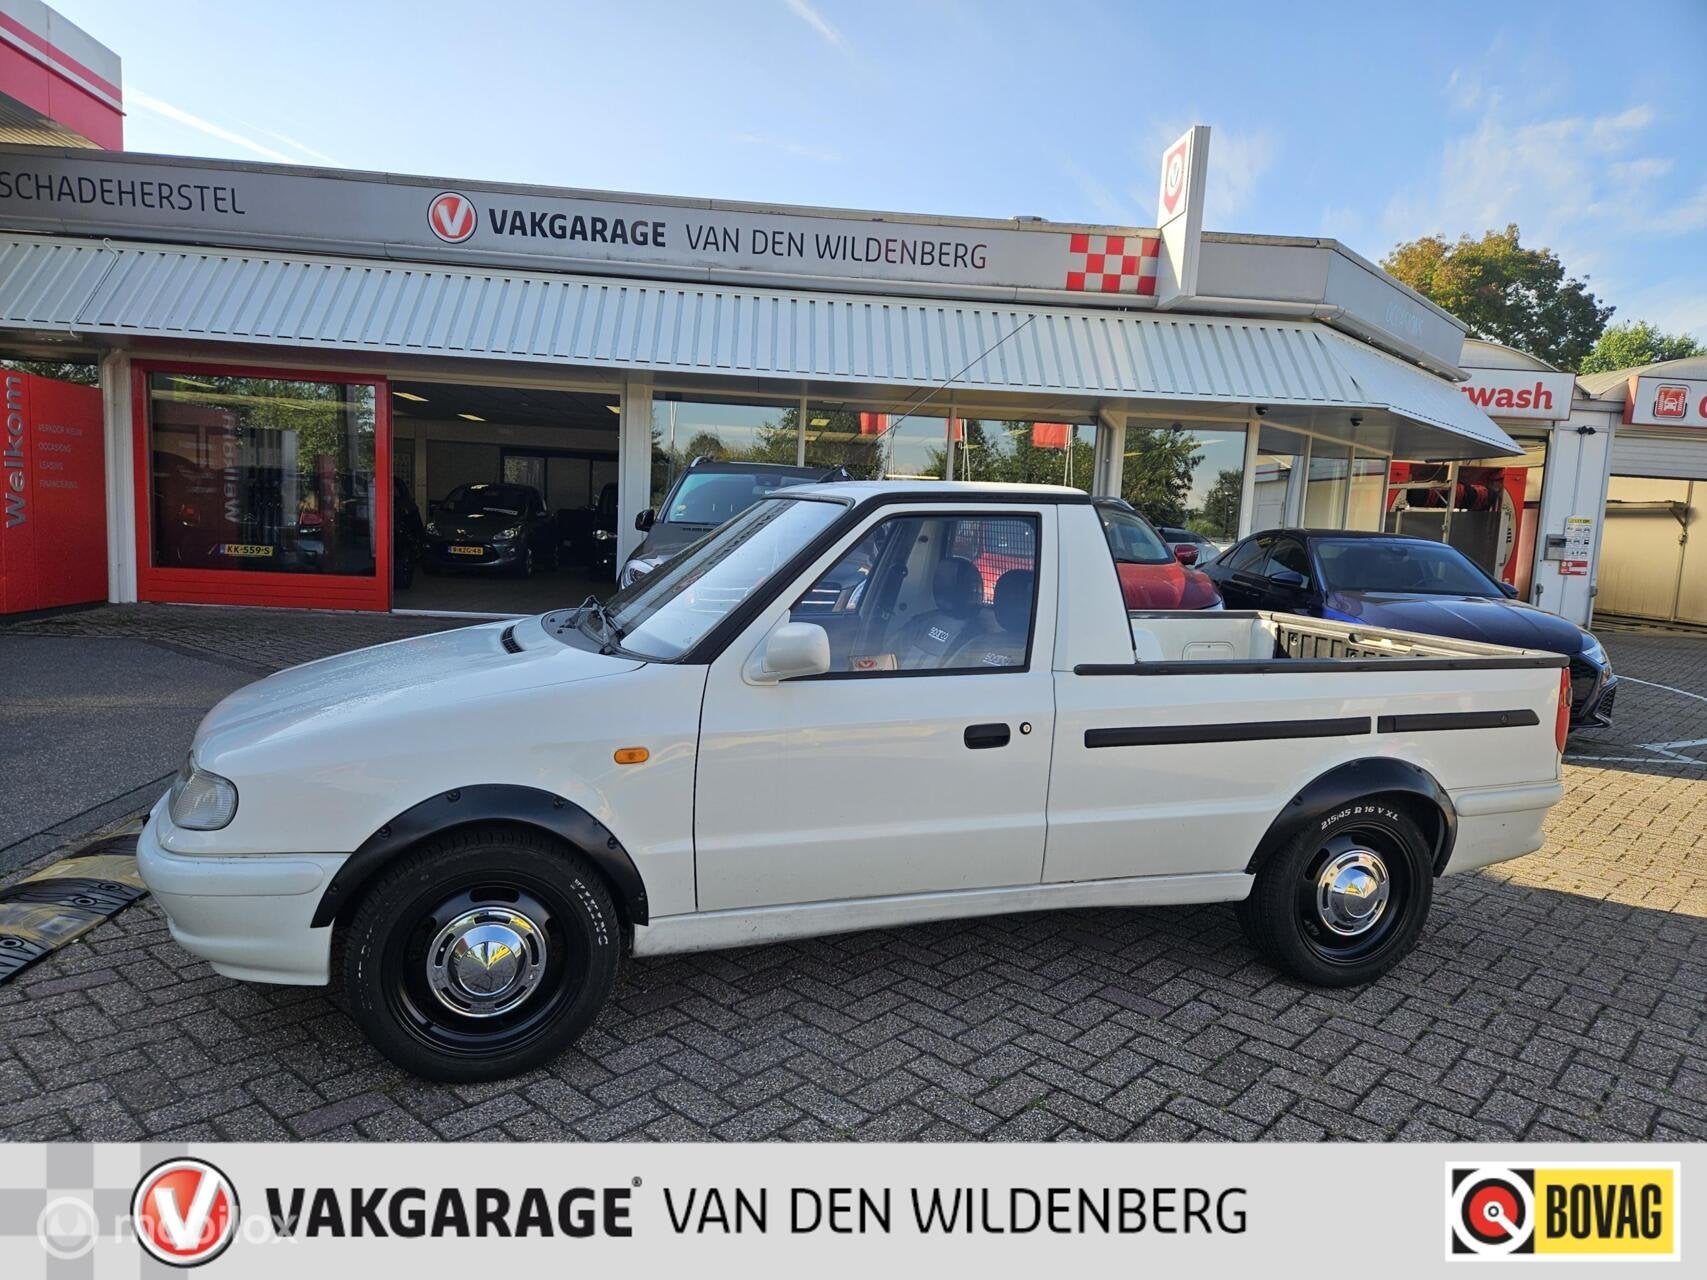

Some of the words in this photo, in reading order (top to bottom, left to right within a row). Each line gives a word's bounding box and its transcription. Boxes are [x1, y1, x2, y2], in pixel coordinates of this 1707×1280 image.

[0, 170, 246, 214] SCHADEHERSTEL
[488, 208, 667, 247] VAKGARAGE
[685, 223, 740, 253] VAN
[752, 229, 804, 258] DEN
[815, 232, 988, 269] WILDENBERG
[4, 376, 27, 529] Welkom
[227, 545, 270, 555] KK-559-S
